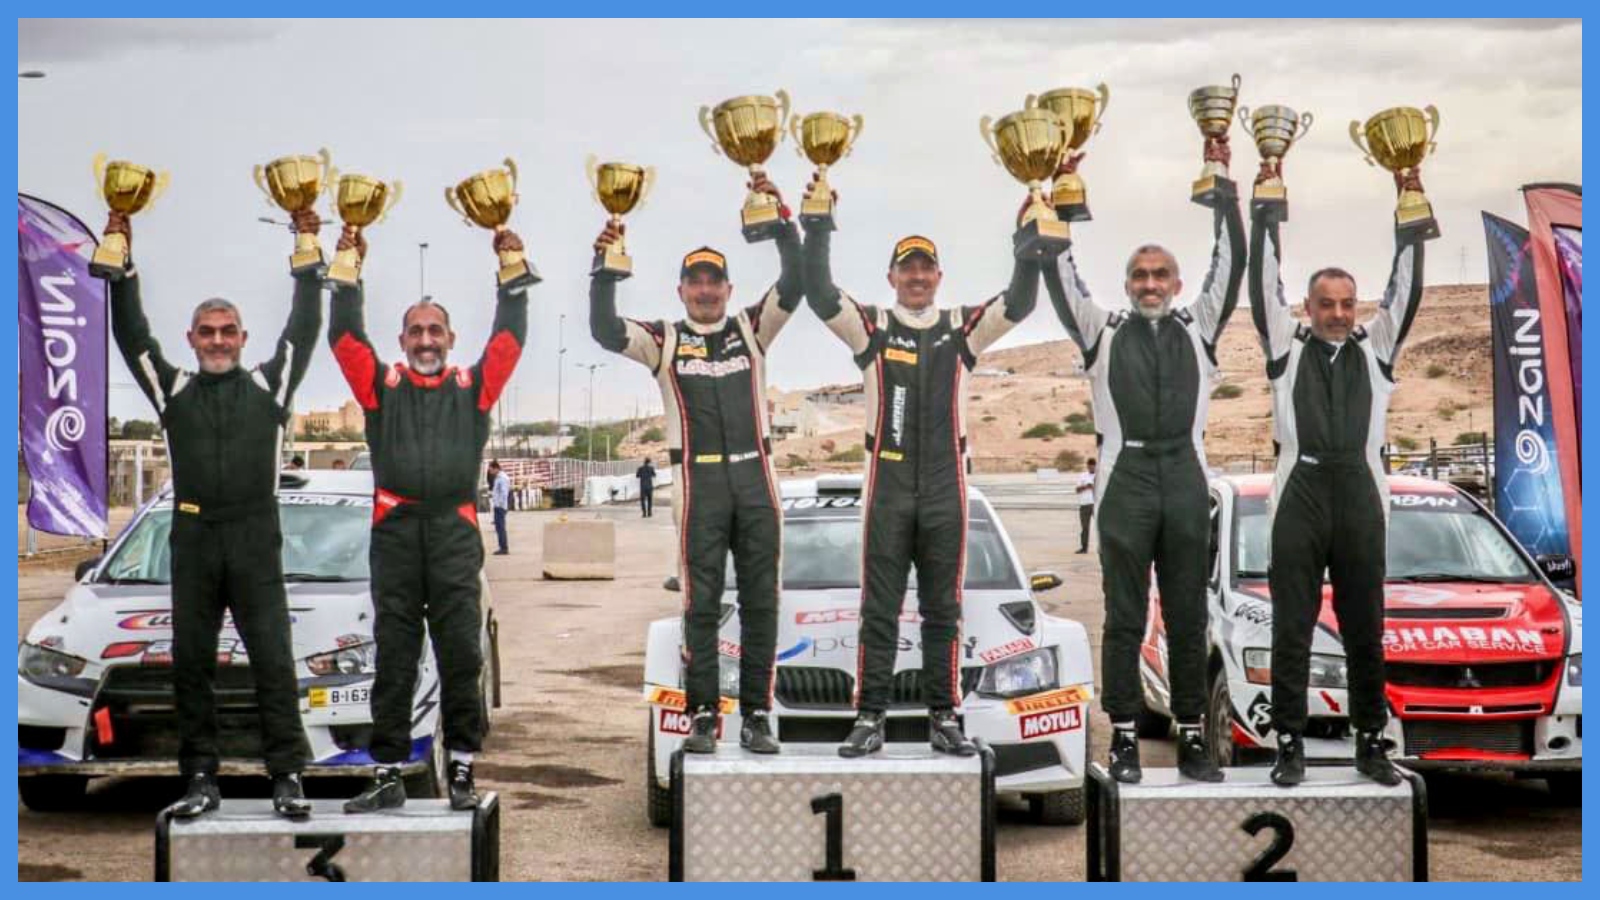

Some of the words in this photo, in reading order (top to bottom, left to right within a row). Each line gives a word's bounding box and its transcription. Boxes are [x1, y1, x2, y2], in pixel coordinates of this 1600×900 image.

[1023, 708, 1080, 738] MOTUL
[811, 792, 856, 882] 1
[1241, 811, 1298, 882] 2
